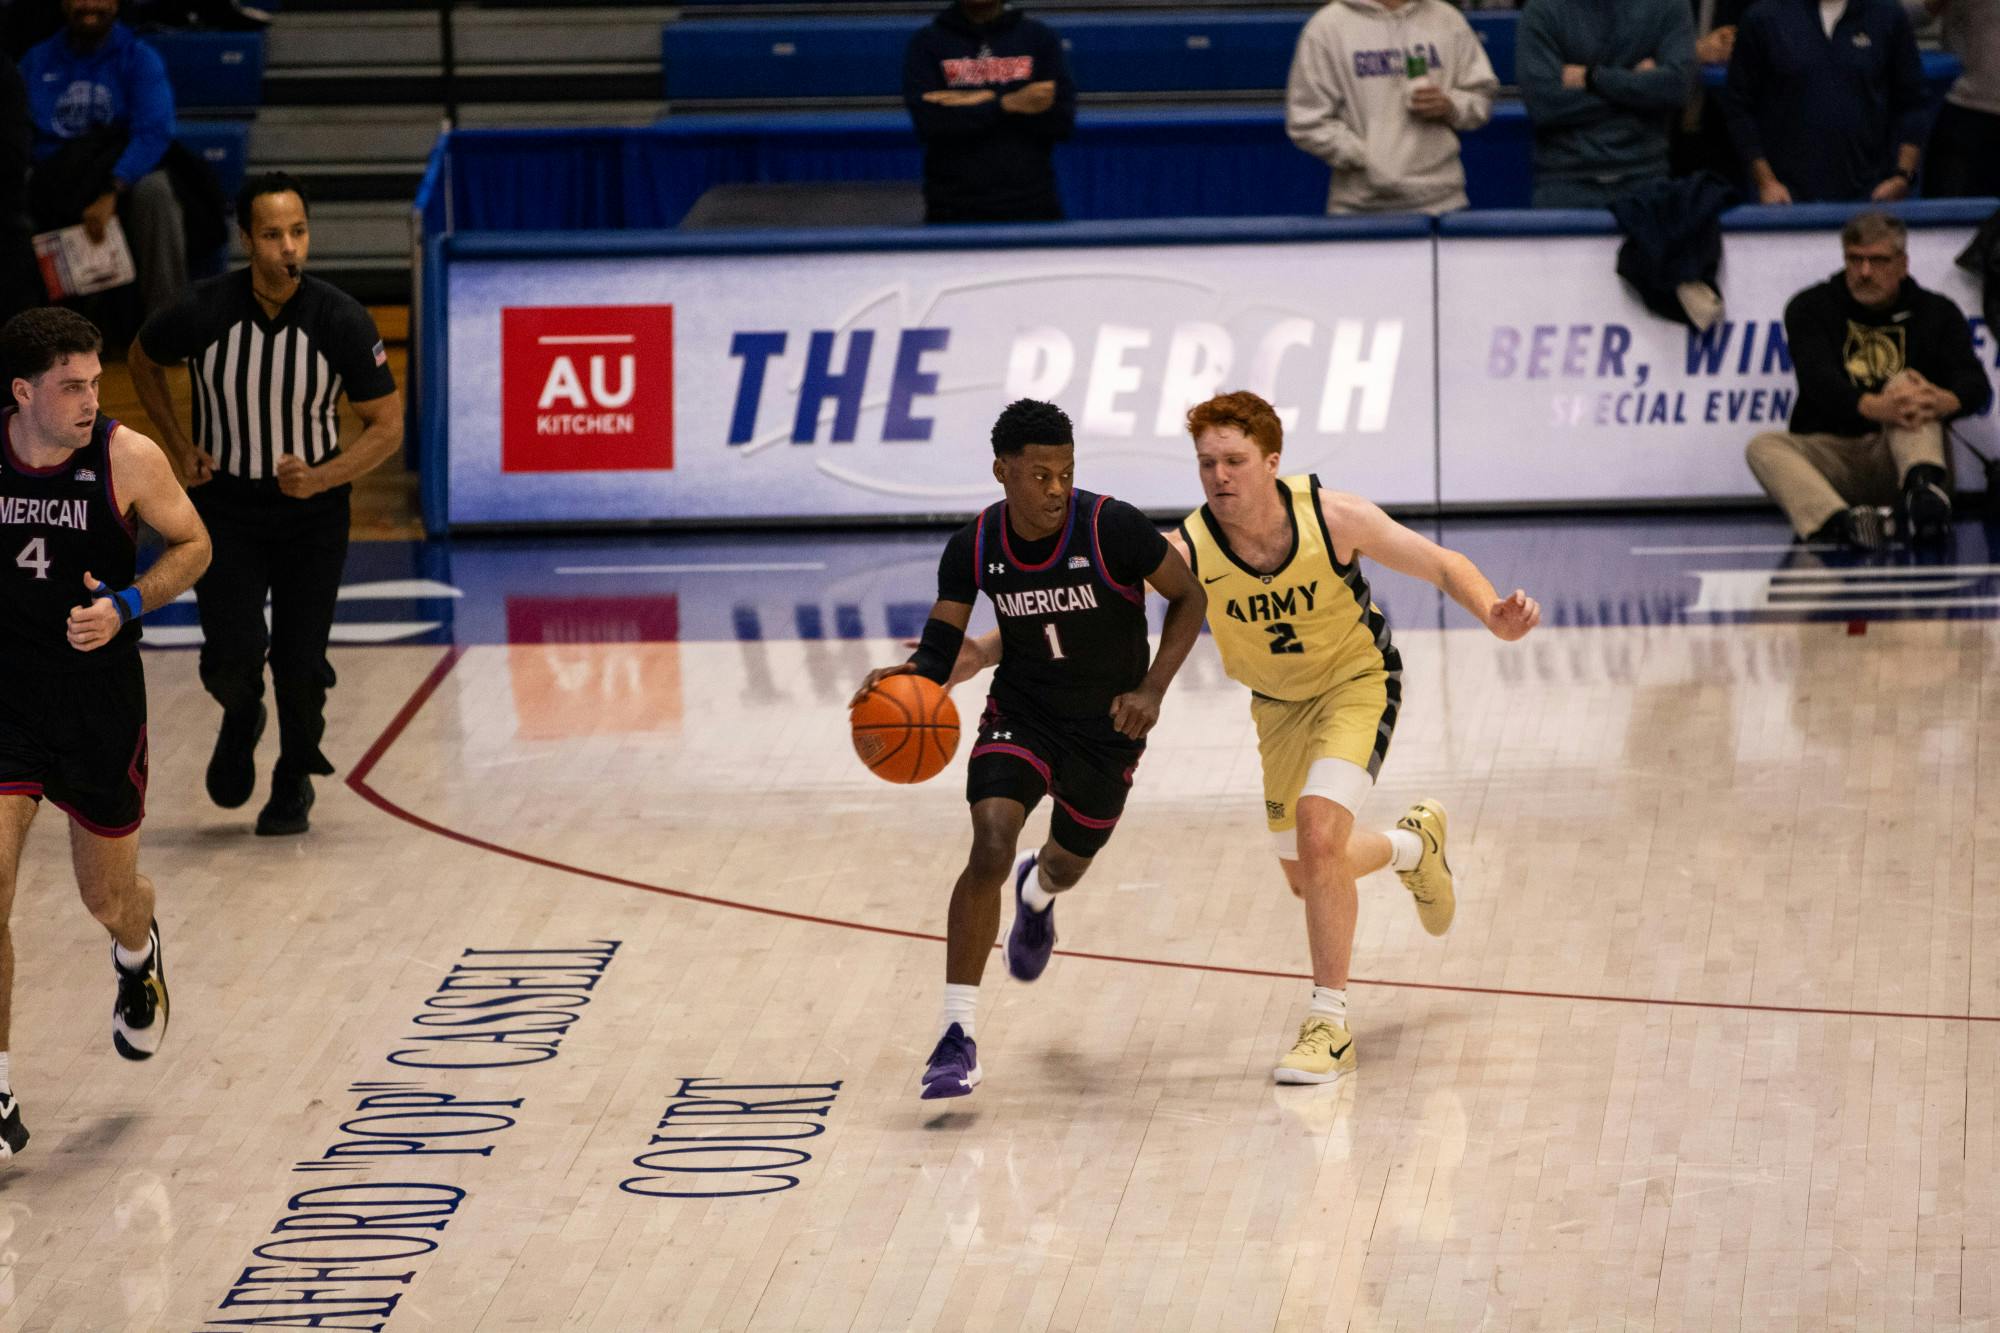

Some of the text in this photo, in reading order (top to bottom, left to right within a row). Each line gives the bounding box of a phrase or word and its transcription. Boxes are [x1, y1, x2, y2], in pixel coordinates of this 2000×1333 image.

[1353, 44, 1442, 78] GONZA
[1487, 320, 1798, 388] BEER, WIN
[537, 354, 636, 409] AU
[727, 316, 1404, 446] THE PERCH
[536, 412, 635, 435] KITCHEN
[1551, 389, 1794, 427] SPECIAL EVEN
[0, 495, 88, 531] MERICAN
[15, 537, 51, 579] 4
[995, 583, 1098, 617] AMERICAN
[1226, 580, 1318, 623] ARMY
[1043, 623, 1066, 659] 1
[1264, 622, 1305, 654] 2
[386, 940, 624, 1069] CASSELL
[291, 1081, 526, 1172] "POP"
[619, 1077, 844, 1199] COURT
[192, 1182, 467, 1333] AFFORD
